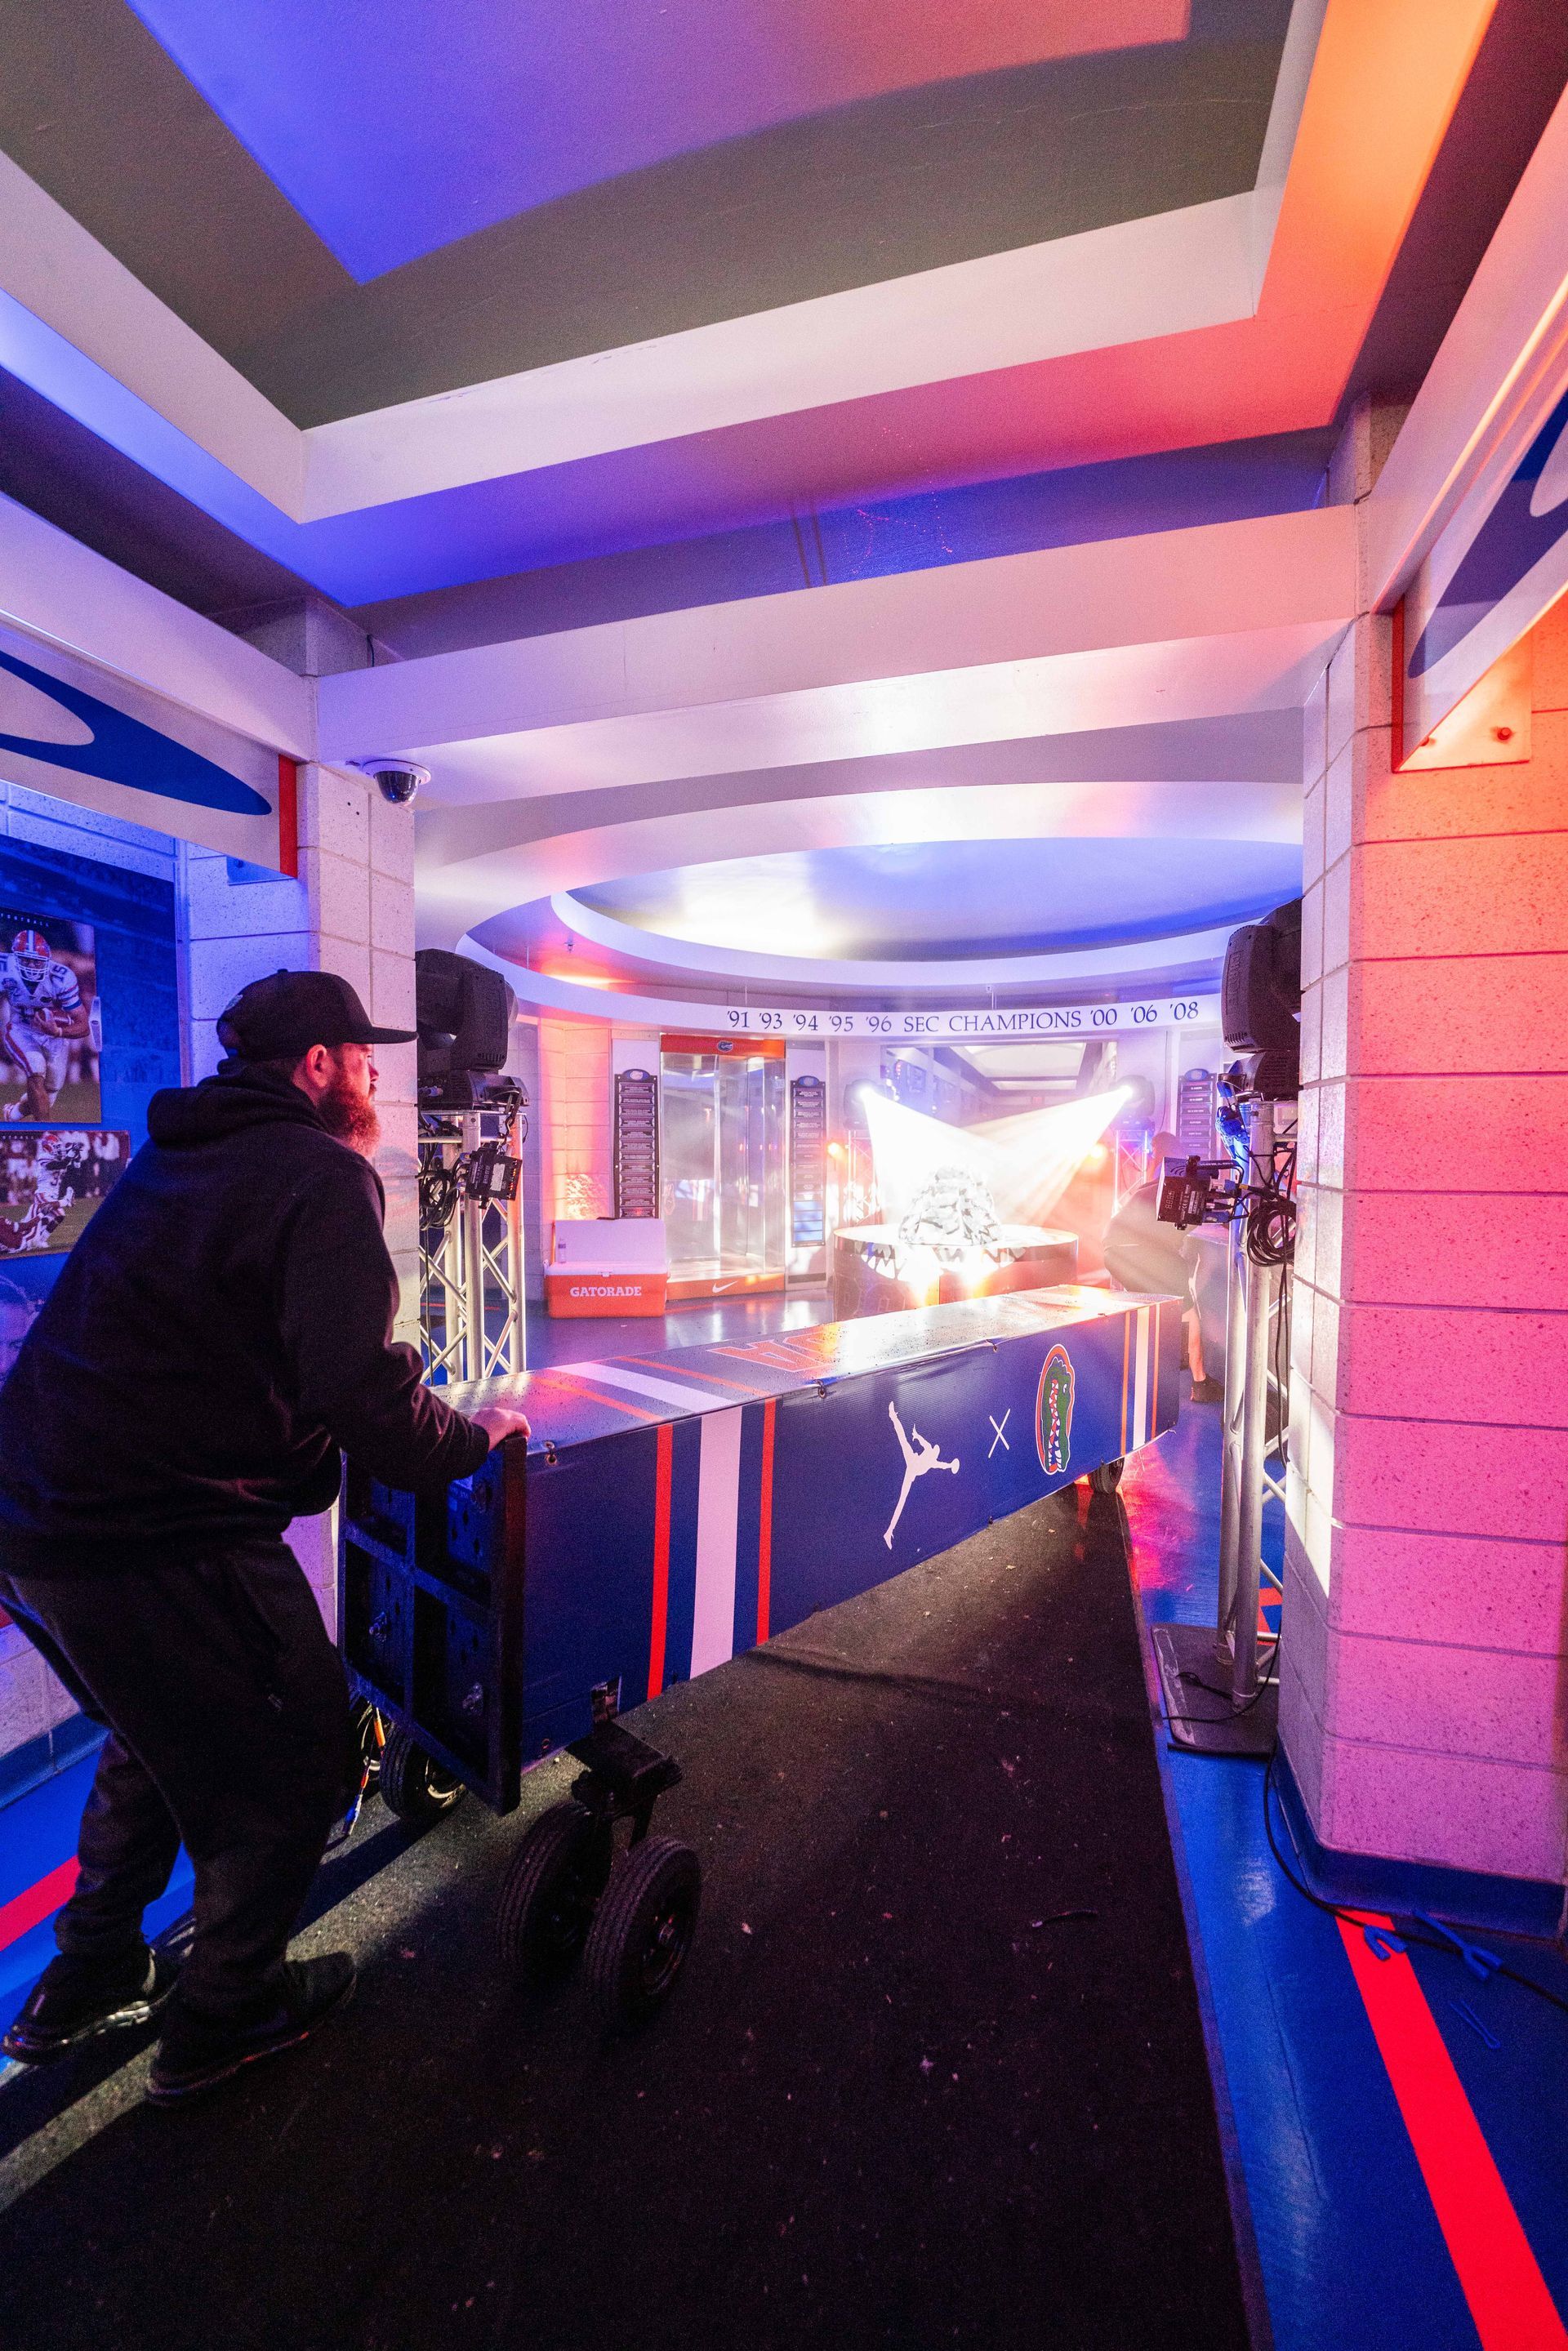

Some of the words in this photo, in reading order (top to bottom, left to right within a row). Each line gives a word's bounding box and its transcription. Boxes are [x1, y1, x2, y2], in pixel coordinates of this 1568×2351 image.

[727, 1010, 751, 1028] '91
[759, 1013, 783, 1030] '93
[793, 1014, 819, 1031] '94
[829, 1015, 854, 1032] '95
[866, 1016, 893, 1033] '96
[903, 1016, 939, 1033] SEC
[948, 1010, 1082, 1032] CHAMPIONS
[1090, 1009, 1118, 1026] '00
[1130, 1004, 1158, 1024] '06
[1169, 1001, 1200, 1021] '08
[569, 1286, 642, 1298] GATORADE
